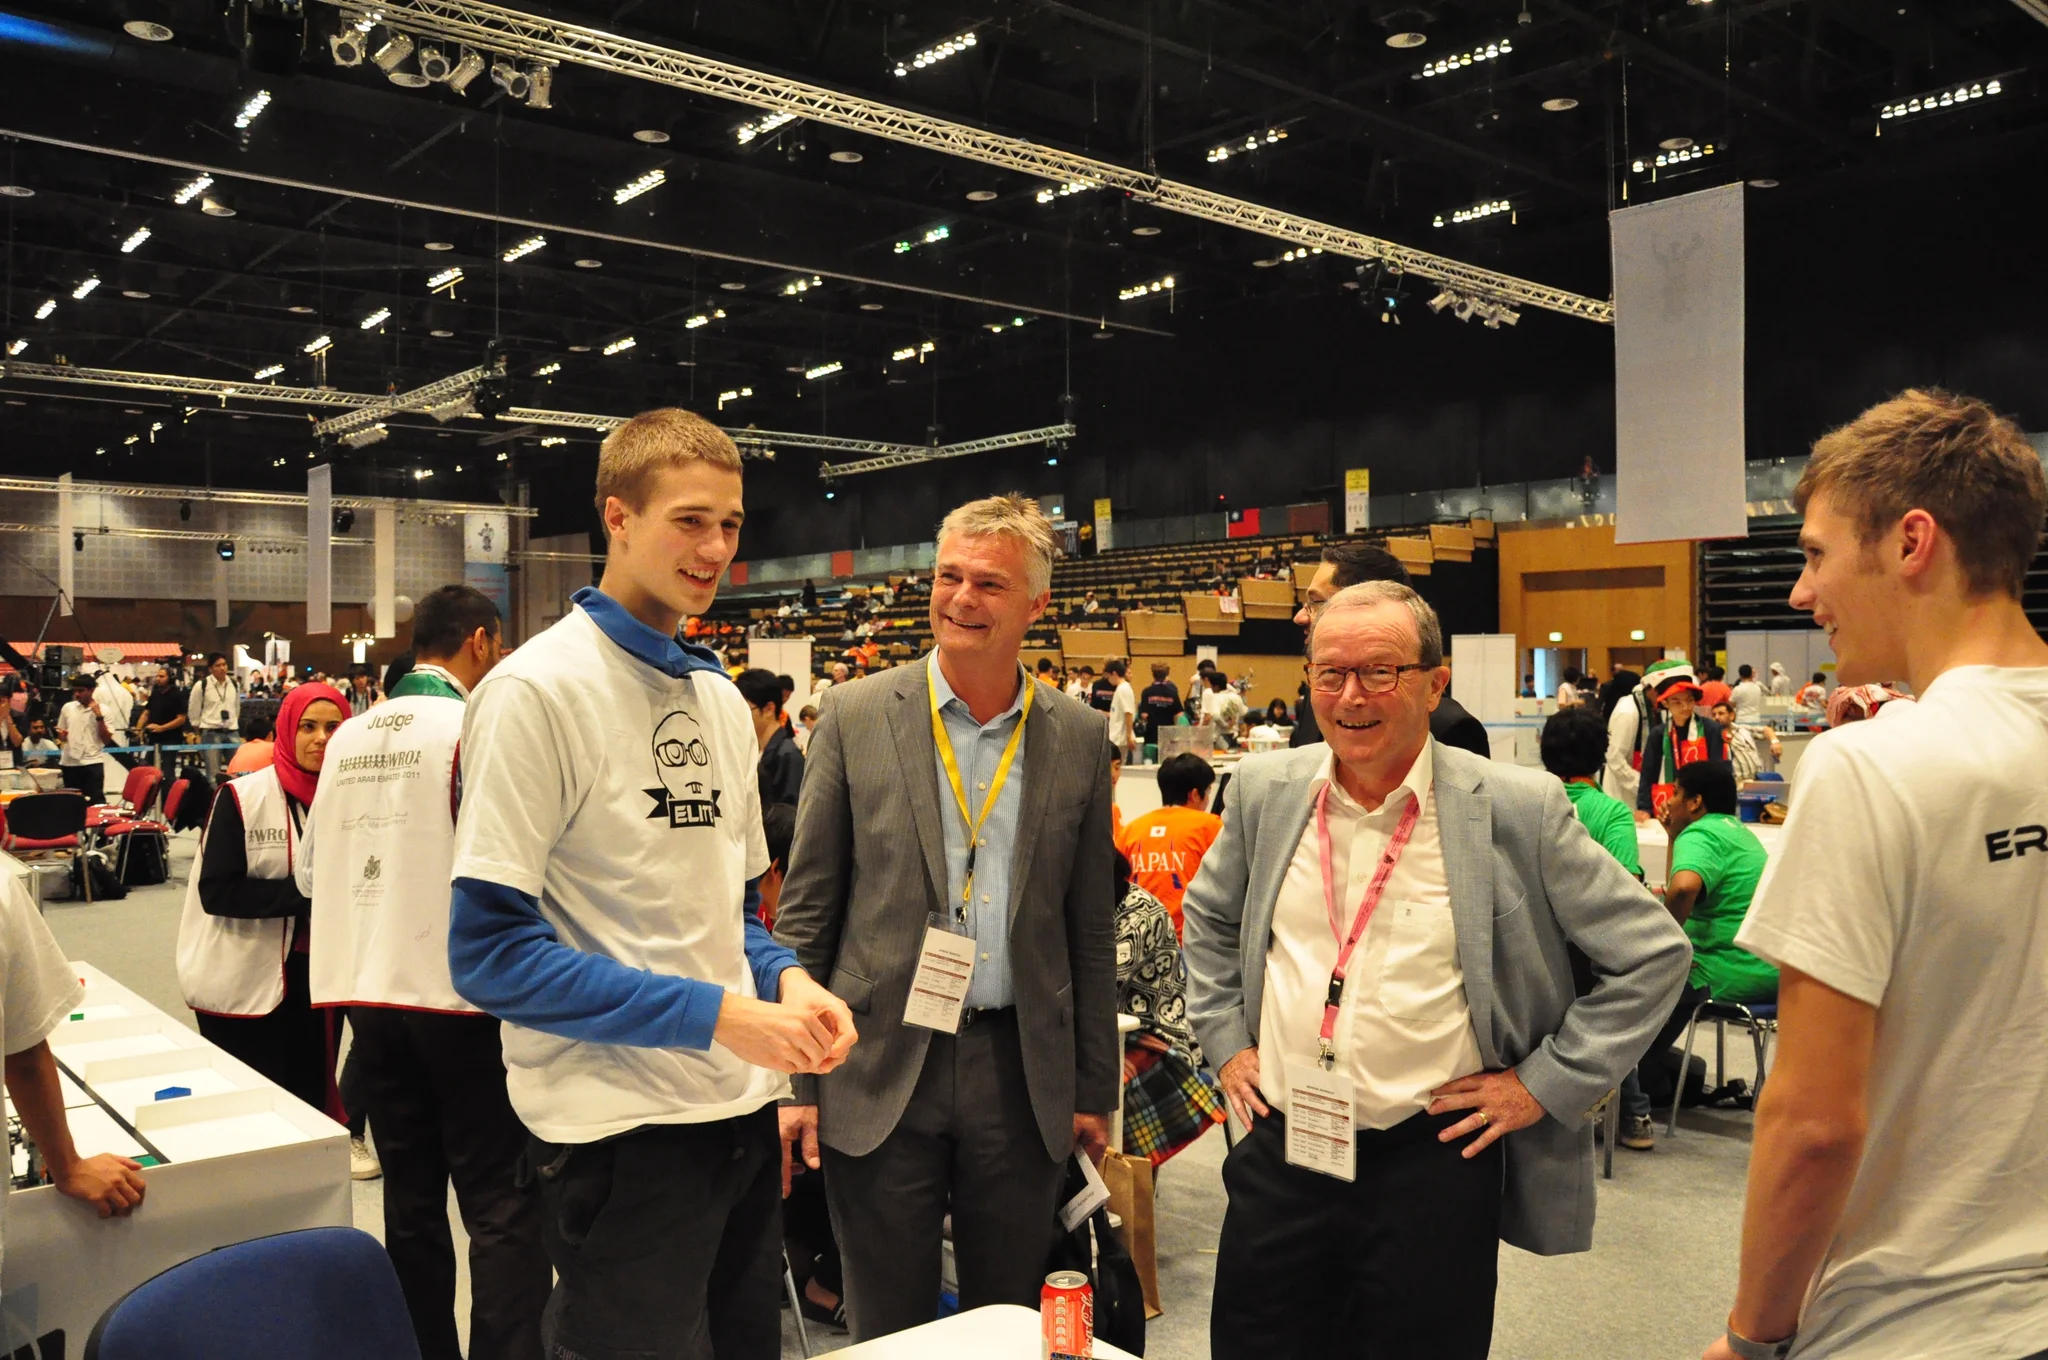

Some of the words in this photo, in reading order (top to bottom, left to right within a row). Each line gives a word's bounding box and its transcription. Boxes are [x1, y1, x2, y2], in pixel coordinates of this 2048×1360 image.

[367, 711, 414, 732] Judge
[387, 750, 415, 768] WRO
[336, 777, 356, 787] UNITED
[357, 775, 376, 784] ARAB
[402, 771, 421, 780] 2011
[254, 827, 289, 842] WRO
[1130, 851, 1187, 873] JAPAN
